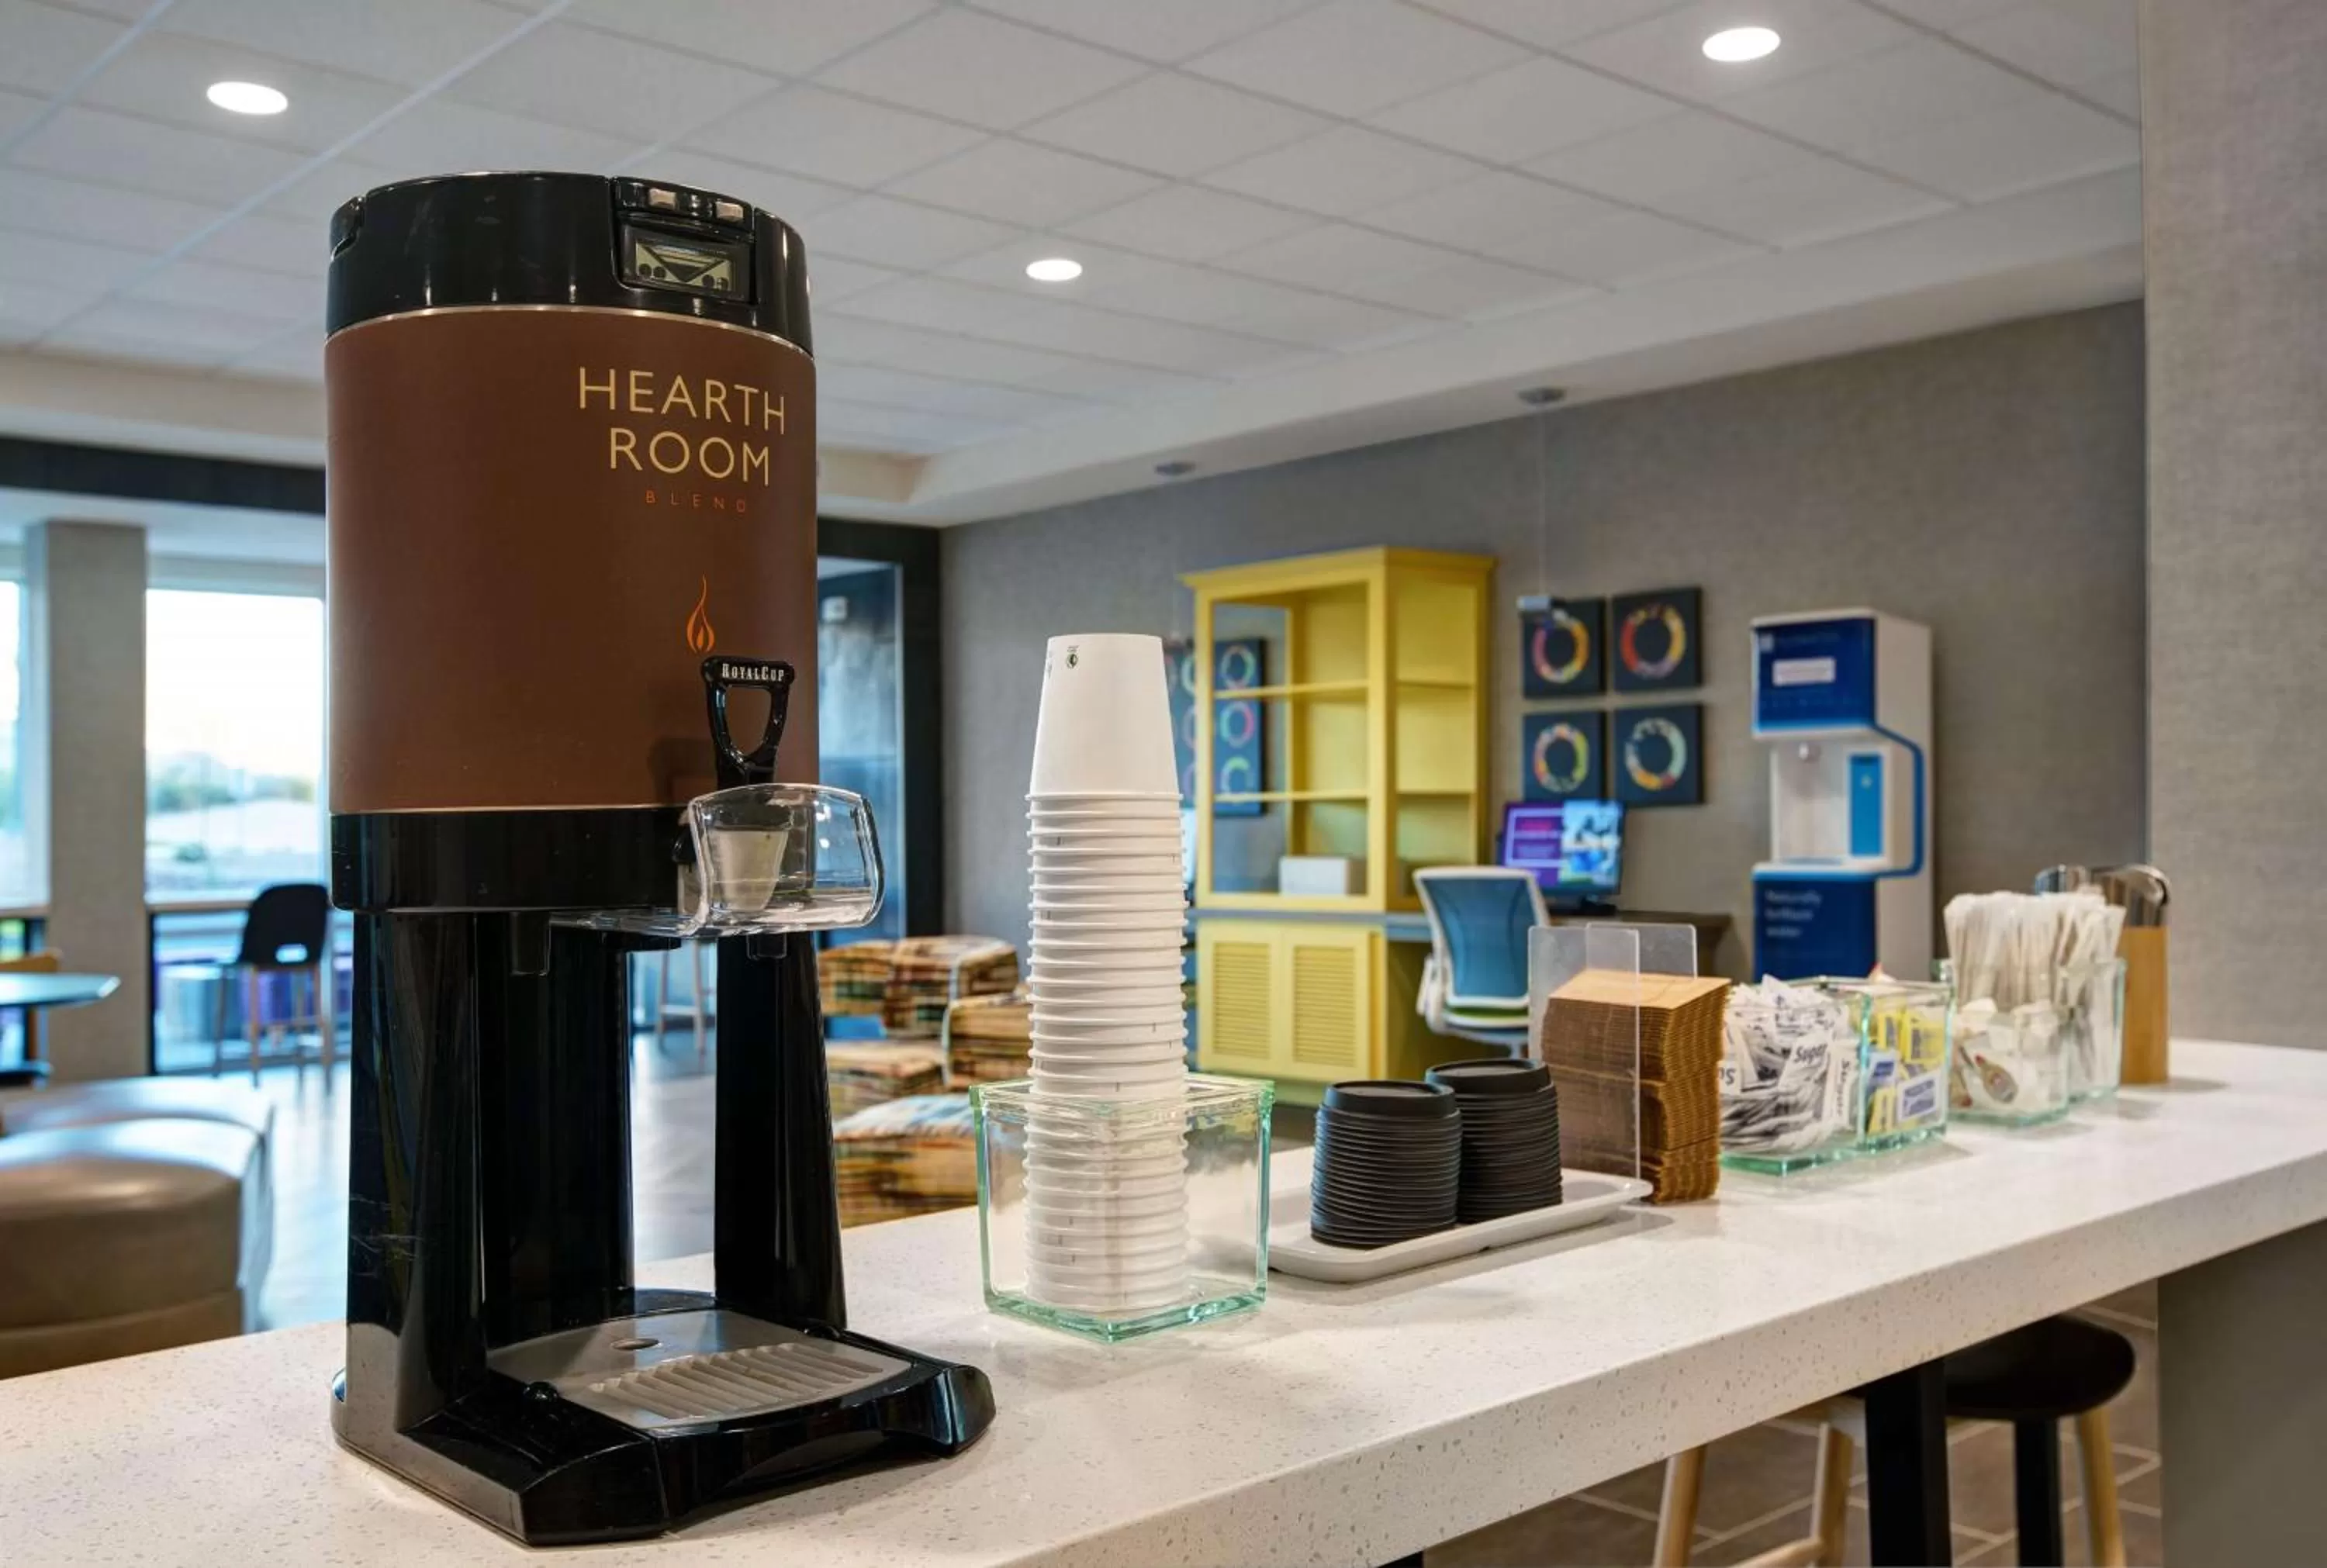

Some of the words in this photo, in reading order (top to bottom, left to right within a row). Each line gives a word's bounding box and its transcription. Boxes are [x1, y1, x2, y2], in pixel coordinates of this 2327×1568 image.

[579, 366, 785, 435] HEARTH
[609, 427, 769, 487] ROOM
[645, 489, 746, 513] BLEND
